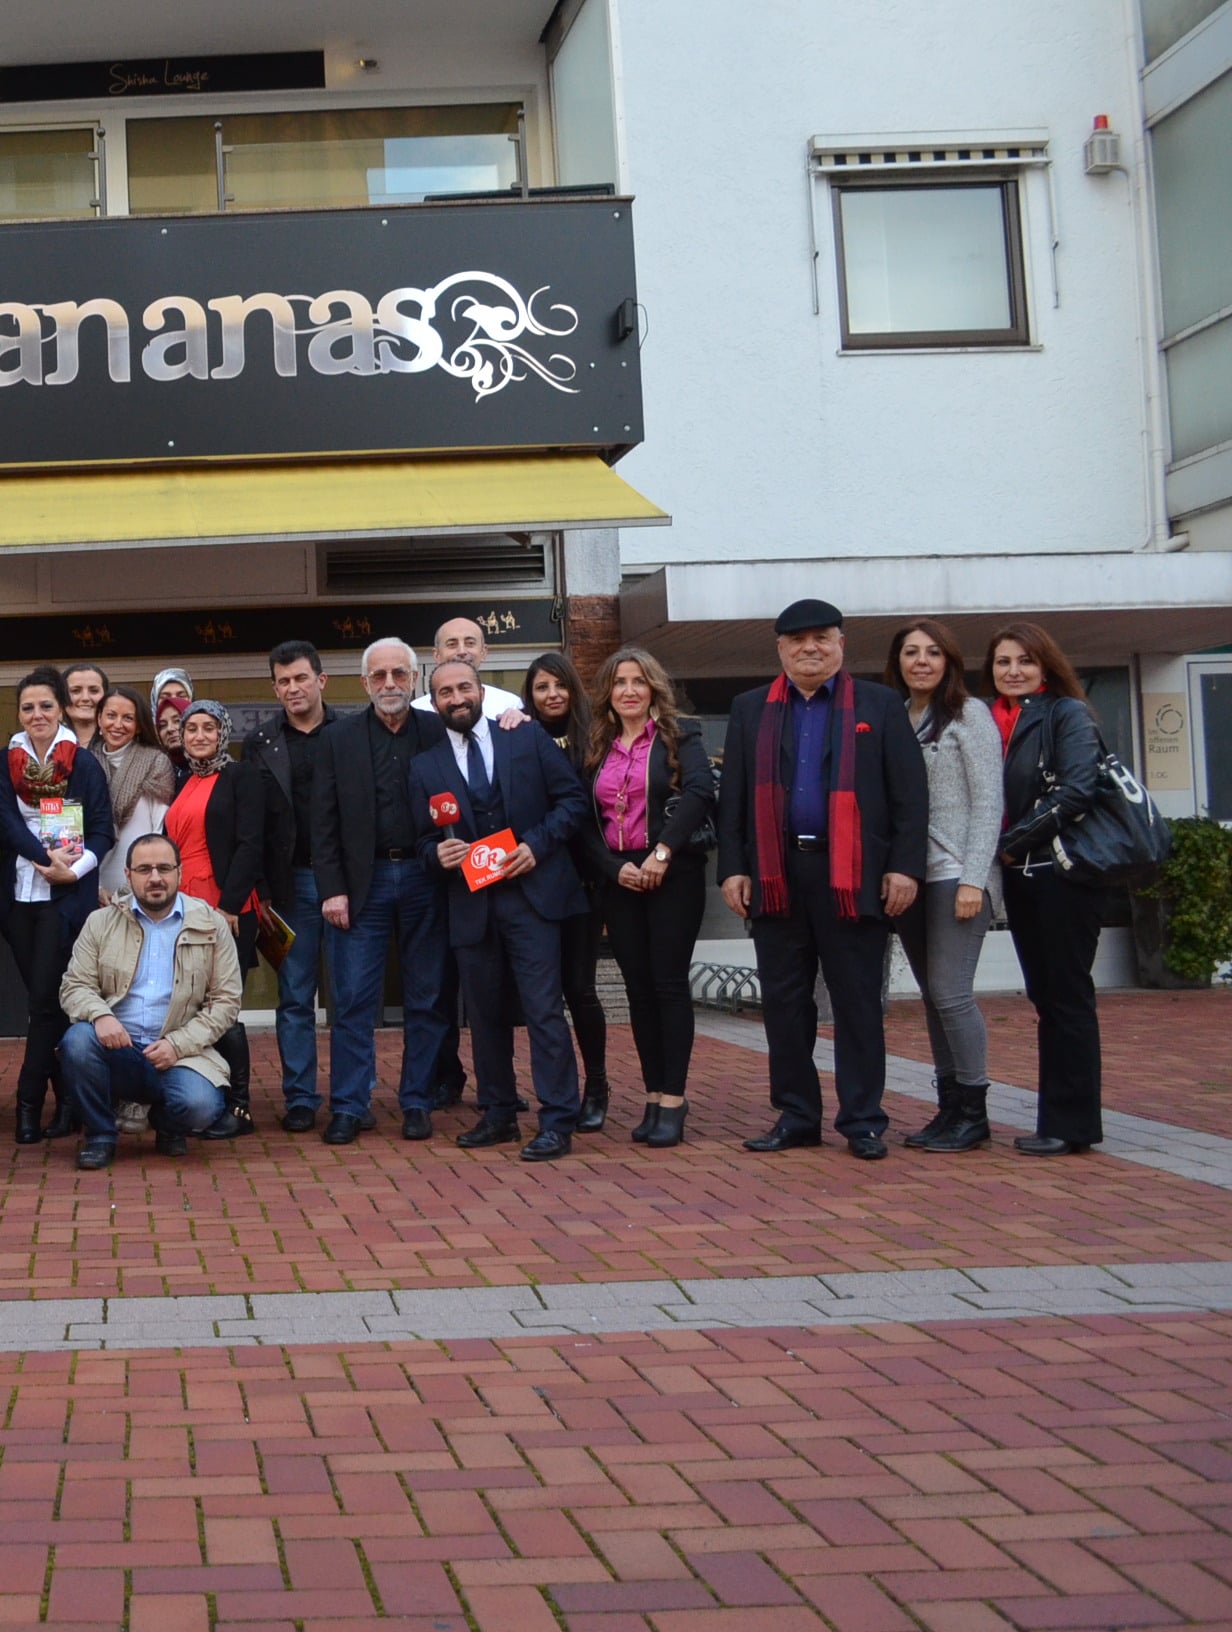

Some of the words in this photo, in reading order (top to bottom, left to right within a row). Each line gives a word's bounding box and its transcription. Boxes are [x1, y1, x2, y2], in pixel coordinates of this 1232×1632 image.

[109, 63, 158, 94] Shisha
[164, 60, 209, 90] Lounge
[1148, 744, 1180, 754] Raum
